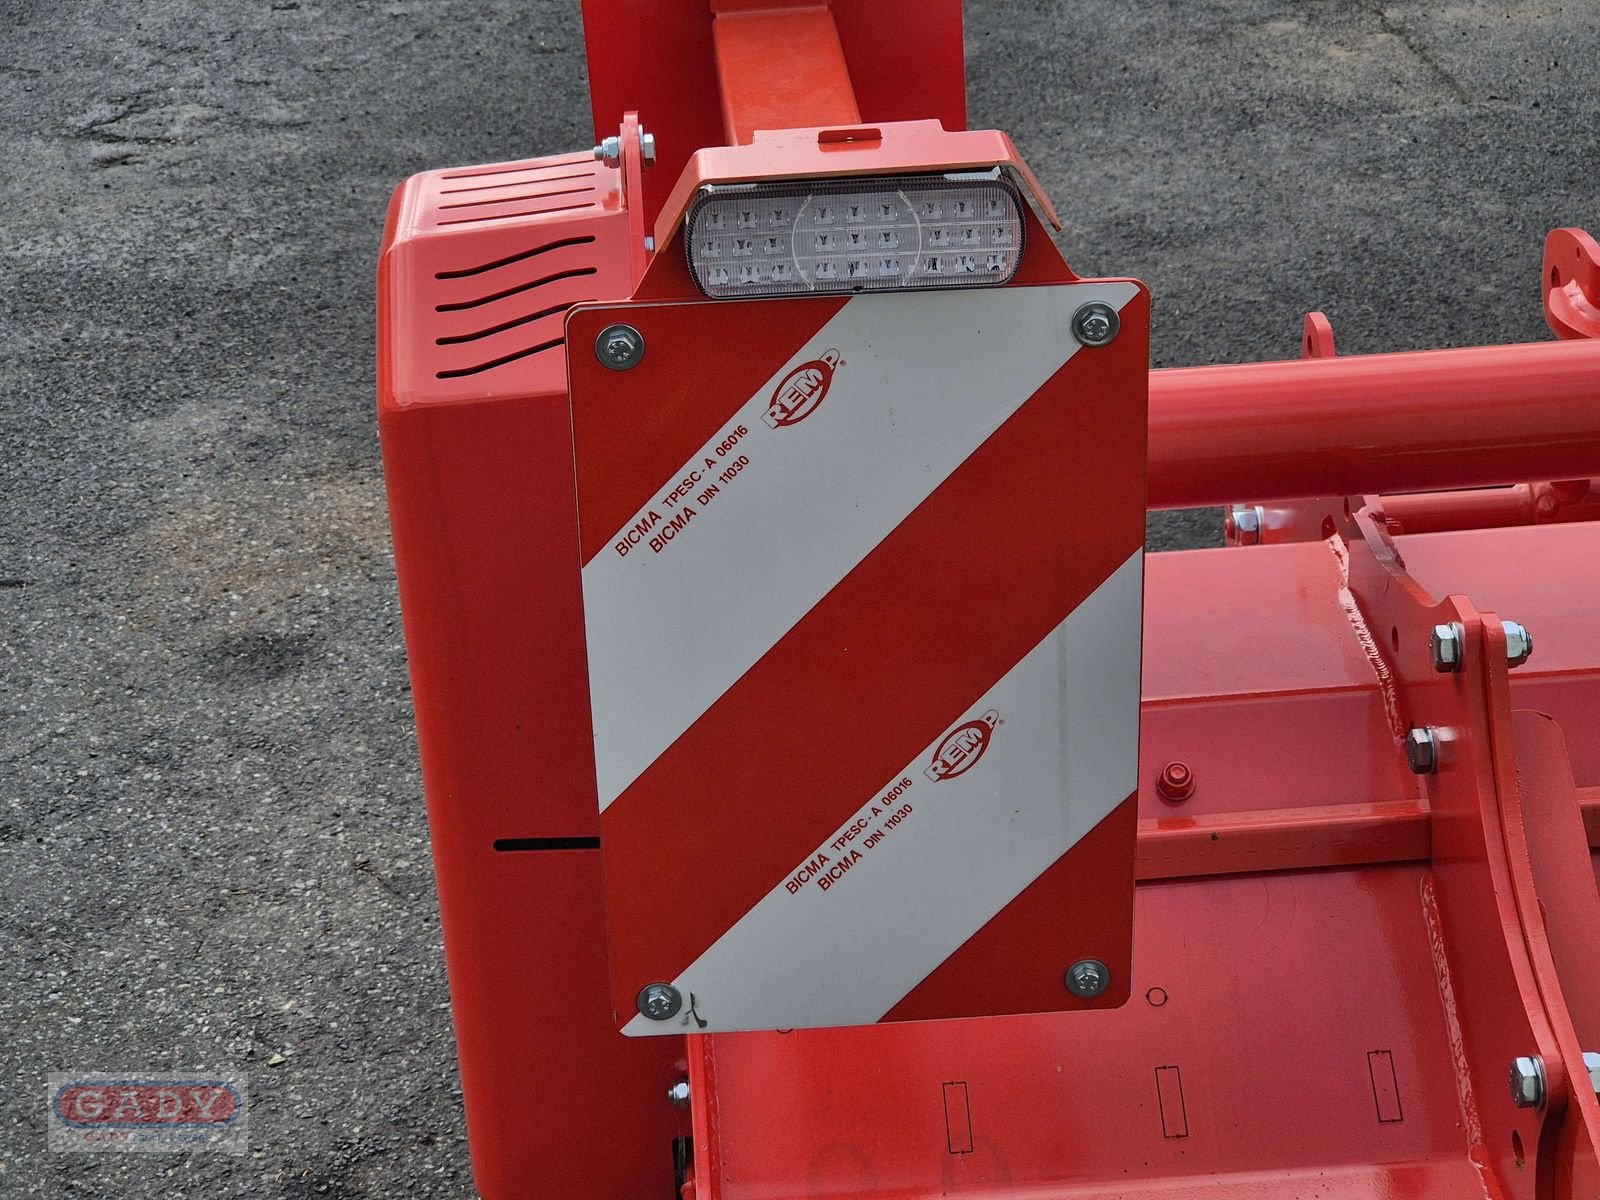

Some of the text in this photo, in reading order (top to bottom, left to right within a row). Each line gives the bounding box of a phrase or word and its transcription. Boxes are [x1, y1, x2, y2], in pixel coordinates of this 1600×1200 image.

[615, 511, 662, 557] BICMA
[716, 425, 748, 457] 06016
[649, 455, 749, 553] BICMA DIN 11030
[785, 853, 830, 895] BICMA
[882, 777, 912, 806] 06016
[817, 804, 913, 891] BICMA DIN 11030
